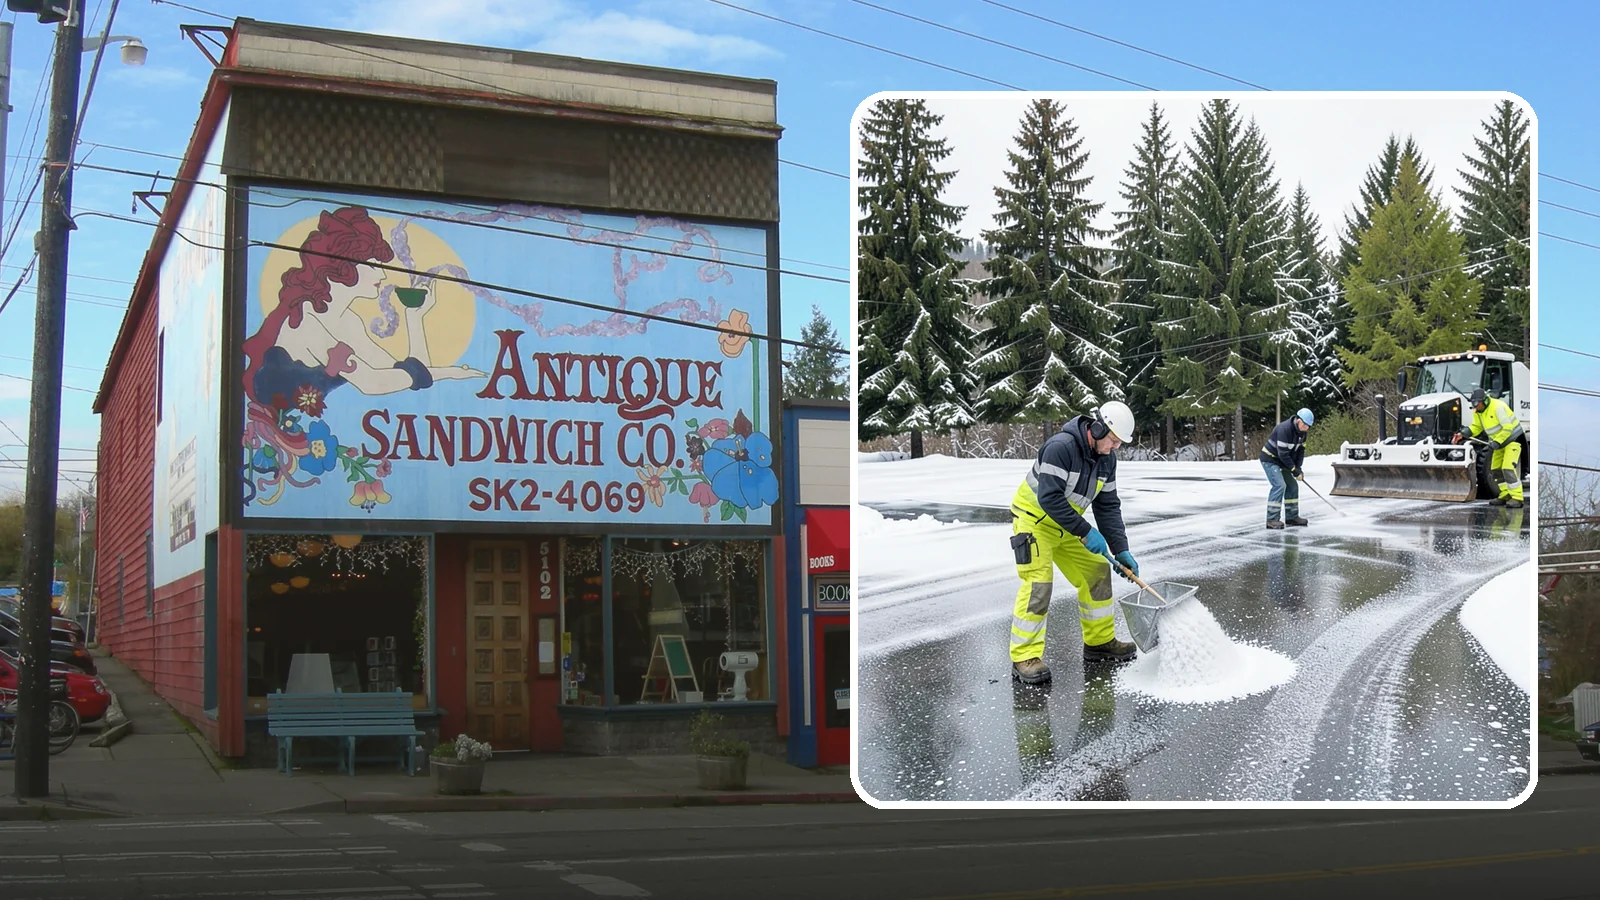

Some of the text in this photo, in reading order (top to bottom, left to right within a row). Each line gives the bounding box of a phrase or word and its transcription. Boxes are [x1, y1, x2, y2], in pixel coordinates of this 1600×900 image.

[476, 330, 724, 420] ANTIQUE
[361, 409, 685, 470] SANDWICH CO.
[468, 478, 645, 513] SK2-4069
[539, 541, 552, 600] 5102
[809, 555, 835, 569] BOOKS
